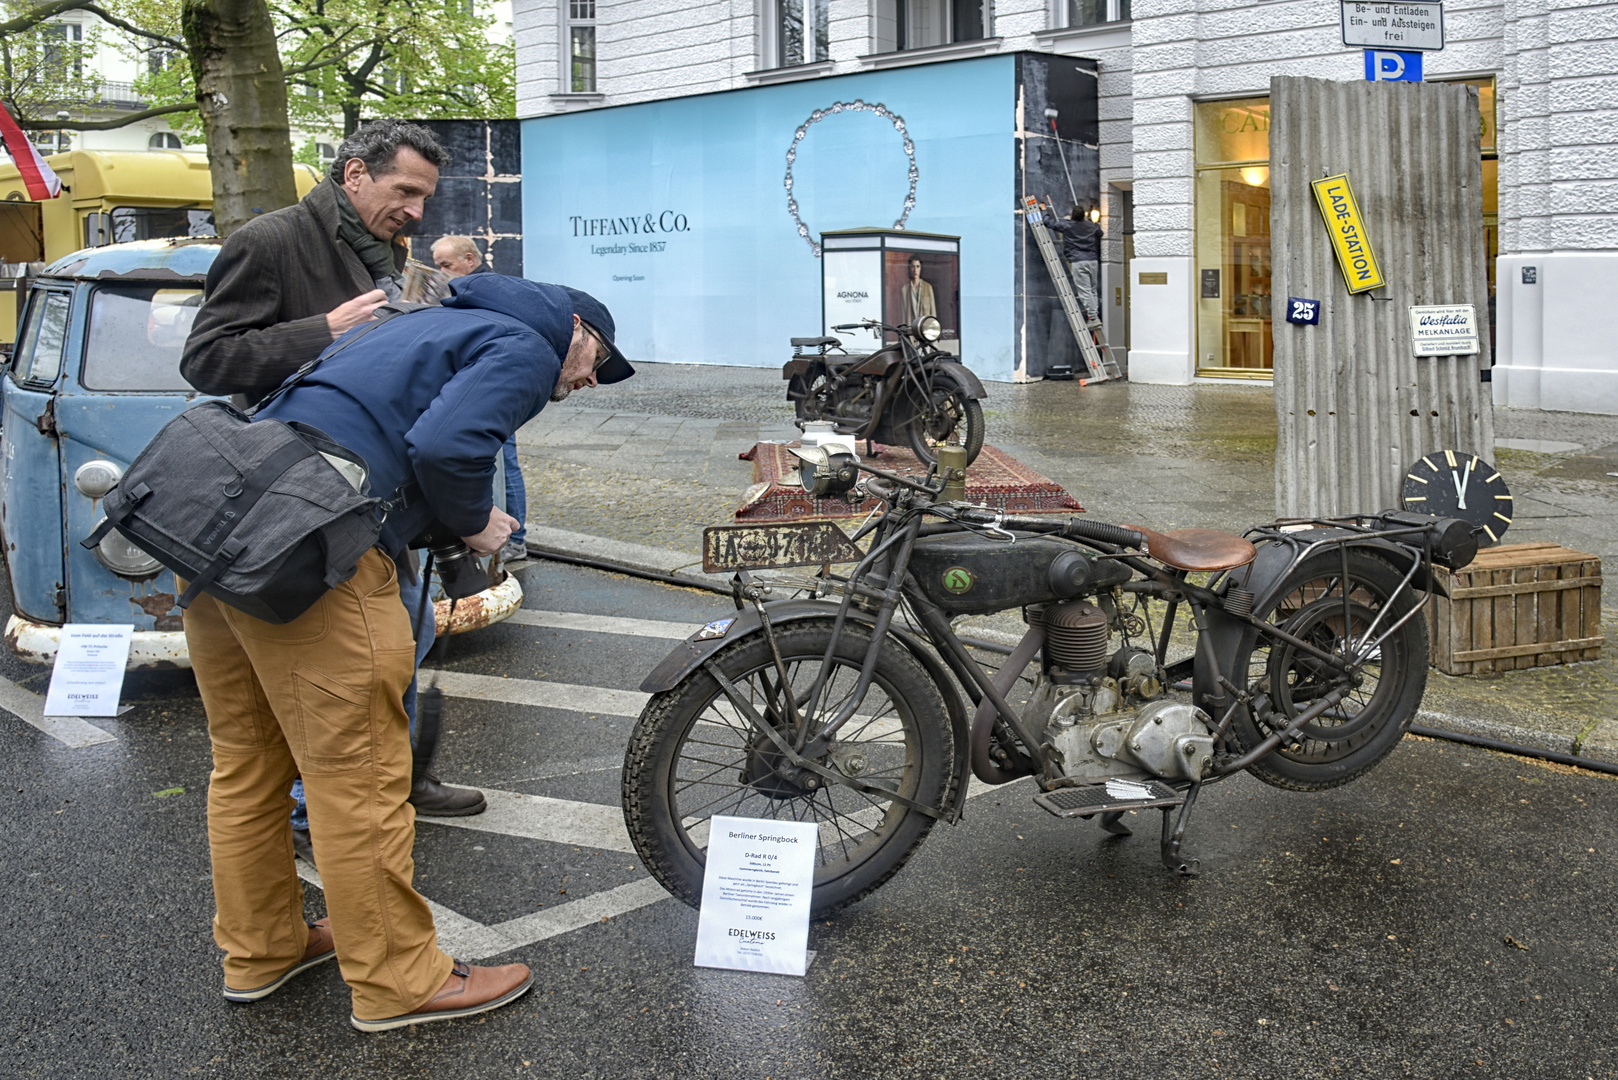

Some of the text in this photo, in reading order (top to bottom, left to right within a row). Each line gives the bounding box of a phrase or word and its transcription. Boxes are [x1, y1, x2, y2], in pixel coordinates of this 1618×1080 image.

[1356, 4, 1429, 16] Be- und Entladen
[1350, 16, 1435, 31] Ein- und Aussteigen
[1384, 31, 1404, 40] frei
[1374, 52, 1405, 81] P
[570, 216, 640, 237] TIFFANY
[643, 213, 656, 234] &
[1328, 186, 1372, 280] LADE-STATION
[591, 241, 666, 256] Legendary Since 1837
[1292, 302, 1315, 320] 25
[1420, 315, 1468, 327] Westfalia
[1418, 328, 1471, 336] MELKANLAGE
[203, 520, 228, 545] TENBA
[729, 831, 798, 844] Berliner Springbock
[728, 928, 776, 940] EDELWEISS
